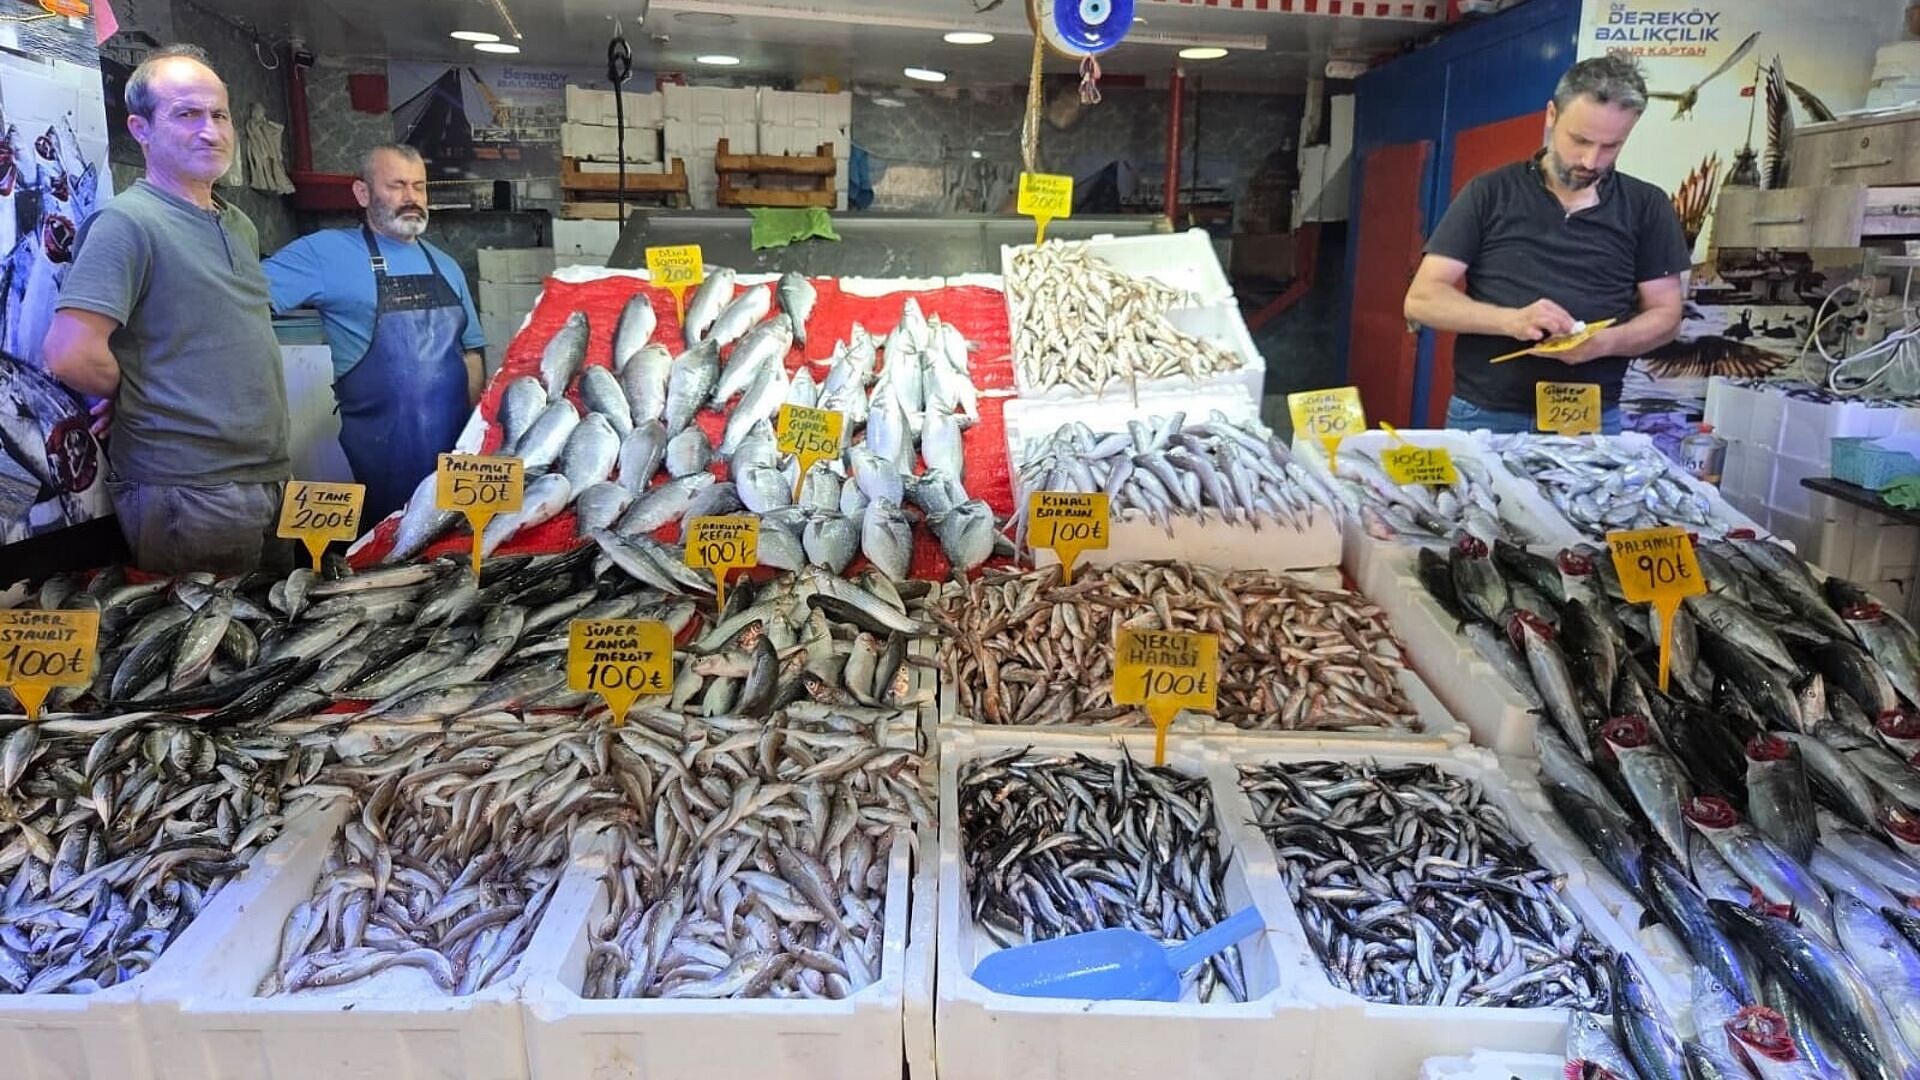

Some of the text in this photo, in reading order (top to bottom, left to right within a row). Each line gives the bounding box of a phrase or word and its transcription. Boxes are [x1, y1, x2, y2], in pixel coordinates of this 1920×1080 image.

[1608, 8, 1721, 25] DEREKÖY
[1595, 27, 1720, 45] BALIKÇILIK
[1648, 46, 1707, 56] KAPTAN
[445, 456, 516, 474] PALAMUT
[294, 485, 353, 509] 4 TANE
[1042, 495, 1092, 506] KINALI
[698, 530, 744, 542] KEFAL
[1616, 534, 1685, 557] PALAMUT
[4, 611, 66, 625] SÜPER
[584, 622, 639, 637] SÜPER
[583, 639, 639, 650] LANGA
[1129, 648, 1199, 668] HAMSİ
